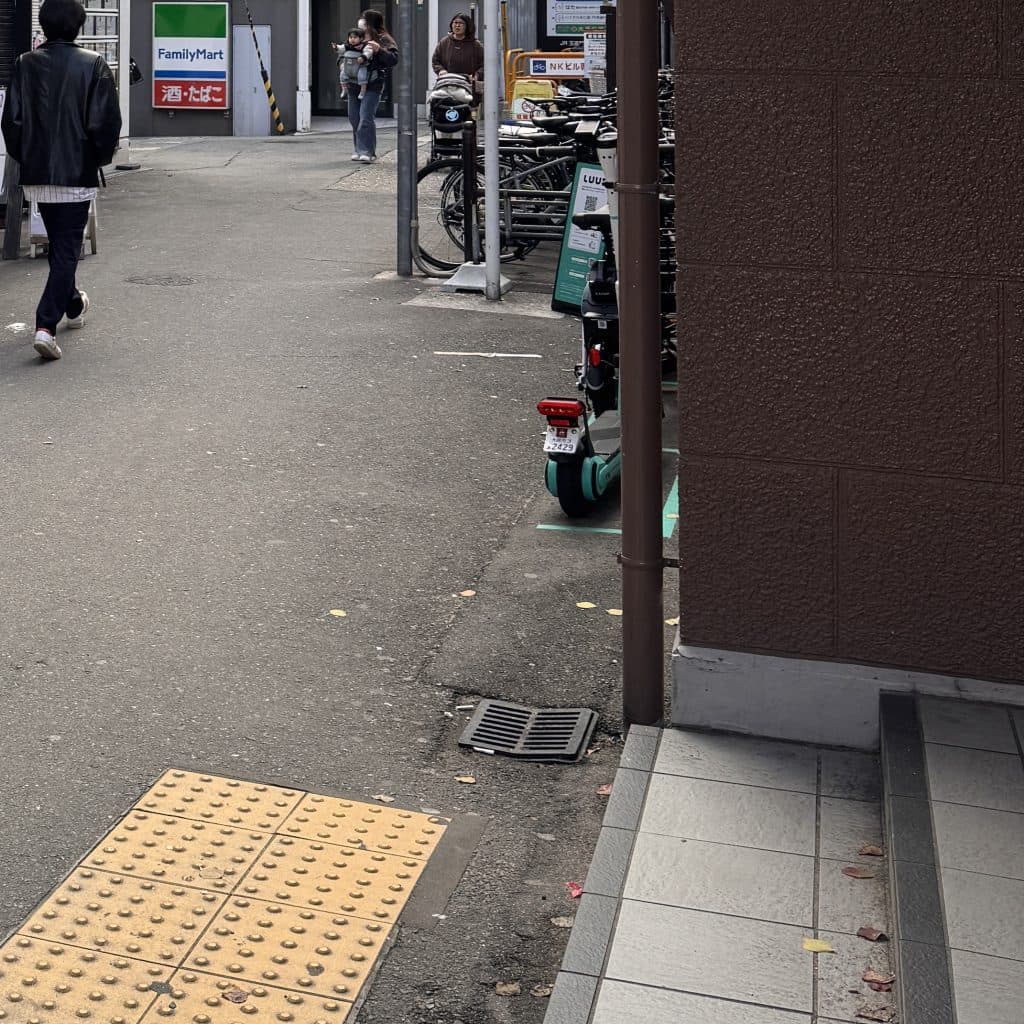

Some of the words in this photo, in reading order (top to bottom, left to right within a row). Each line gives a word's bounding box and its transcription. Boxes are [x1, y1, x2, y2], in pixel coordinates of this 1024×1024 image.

[158, 48, 224, 61] FamilyMart
[162, 85, 223, 103] 酒・たばこ
